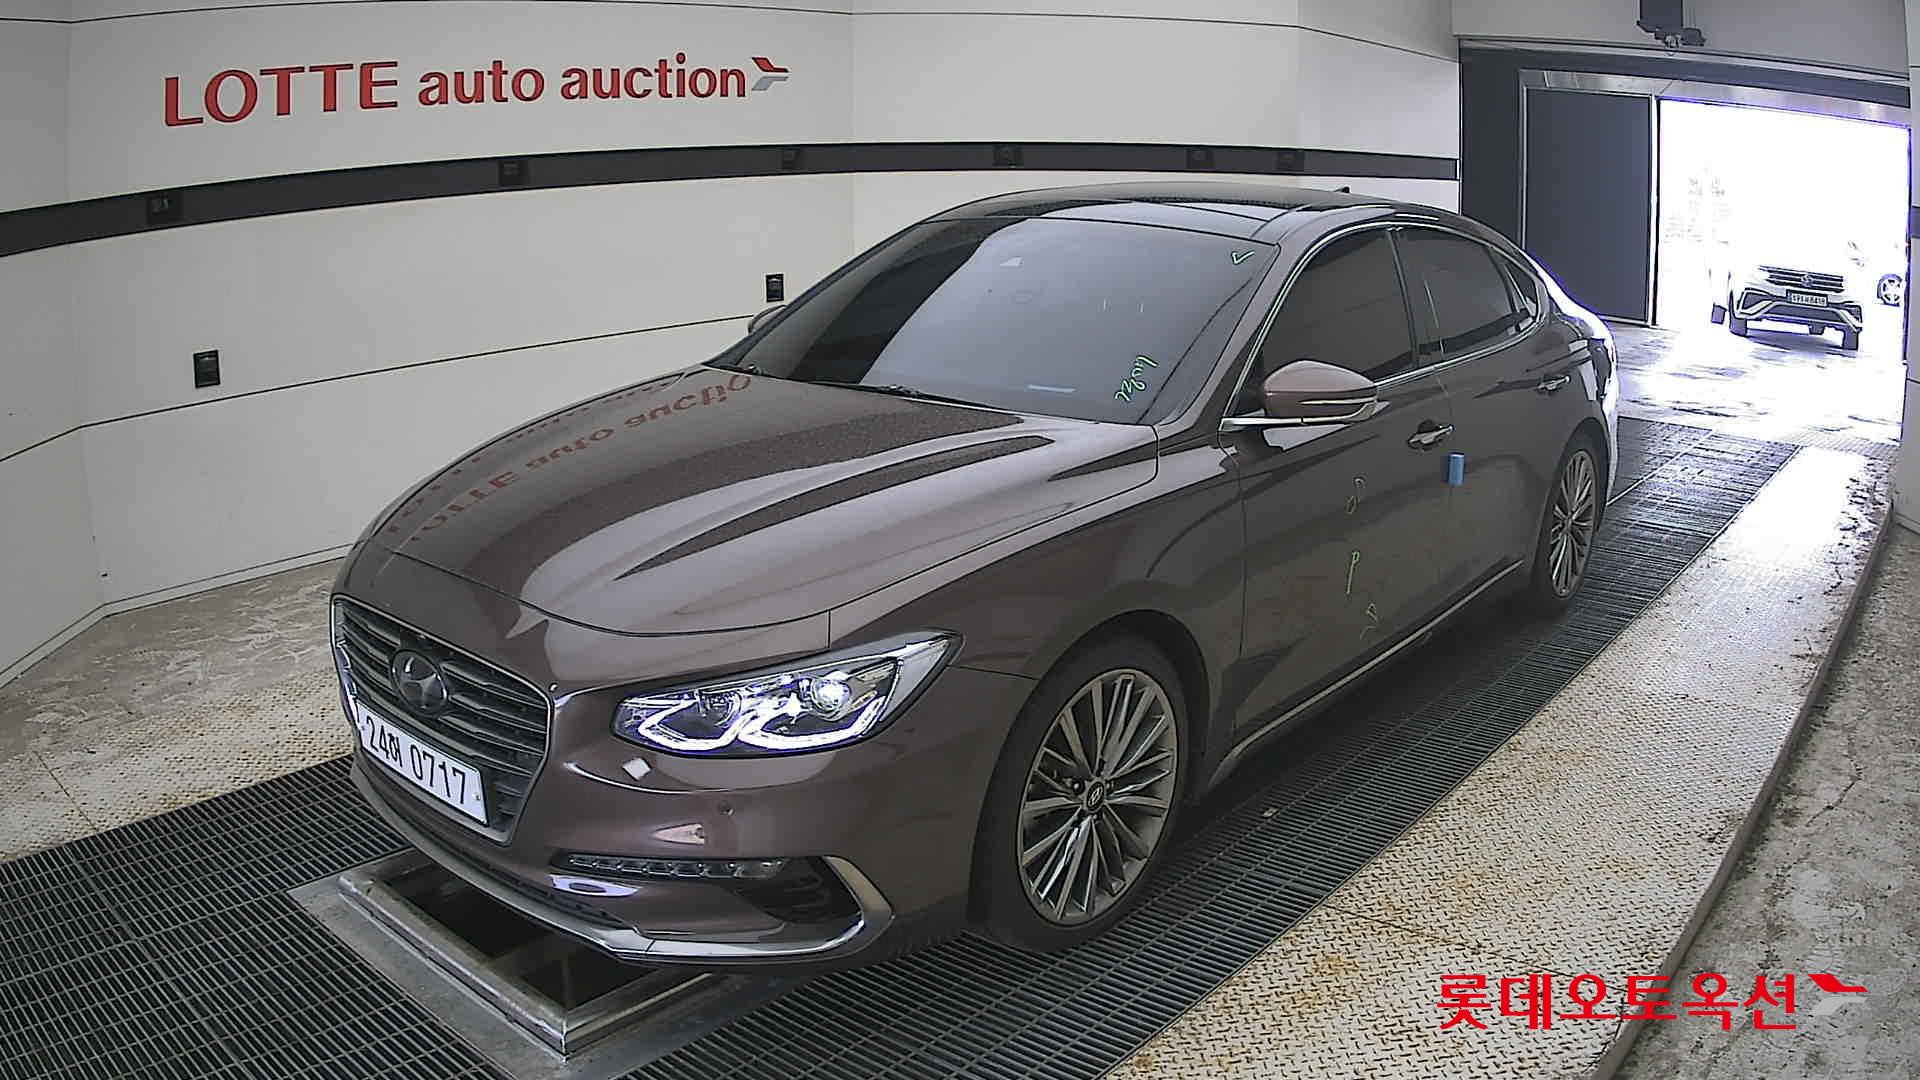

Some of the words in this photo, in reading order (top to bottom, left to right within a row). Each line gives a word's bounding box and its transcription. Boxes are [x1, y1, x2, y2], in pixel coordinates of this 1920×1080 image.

[163, 60, 399, 127] LOTTE
[418, 60, 546, 106] auto
[560, 52, 748, 100] auction
[410, 745, 466, 805] 0717
